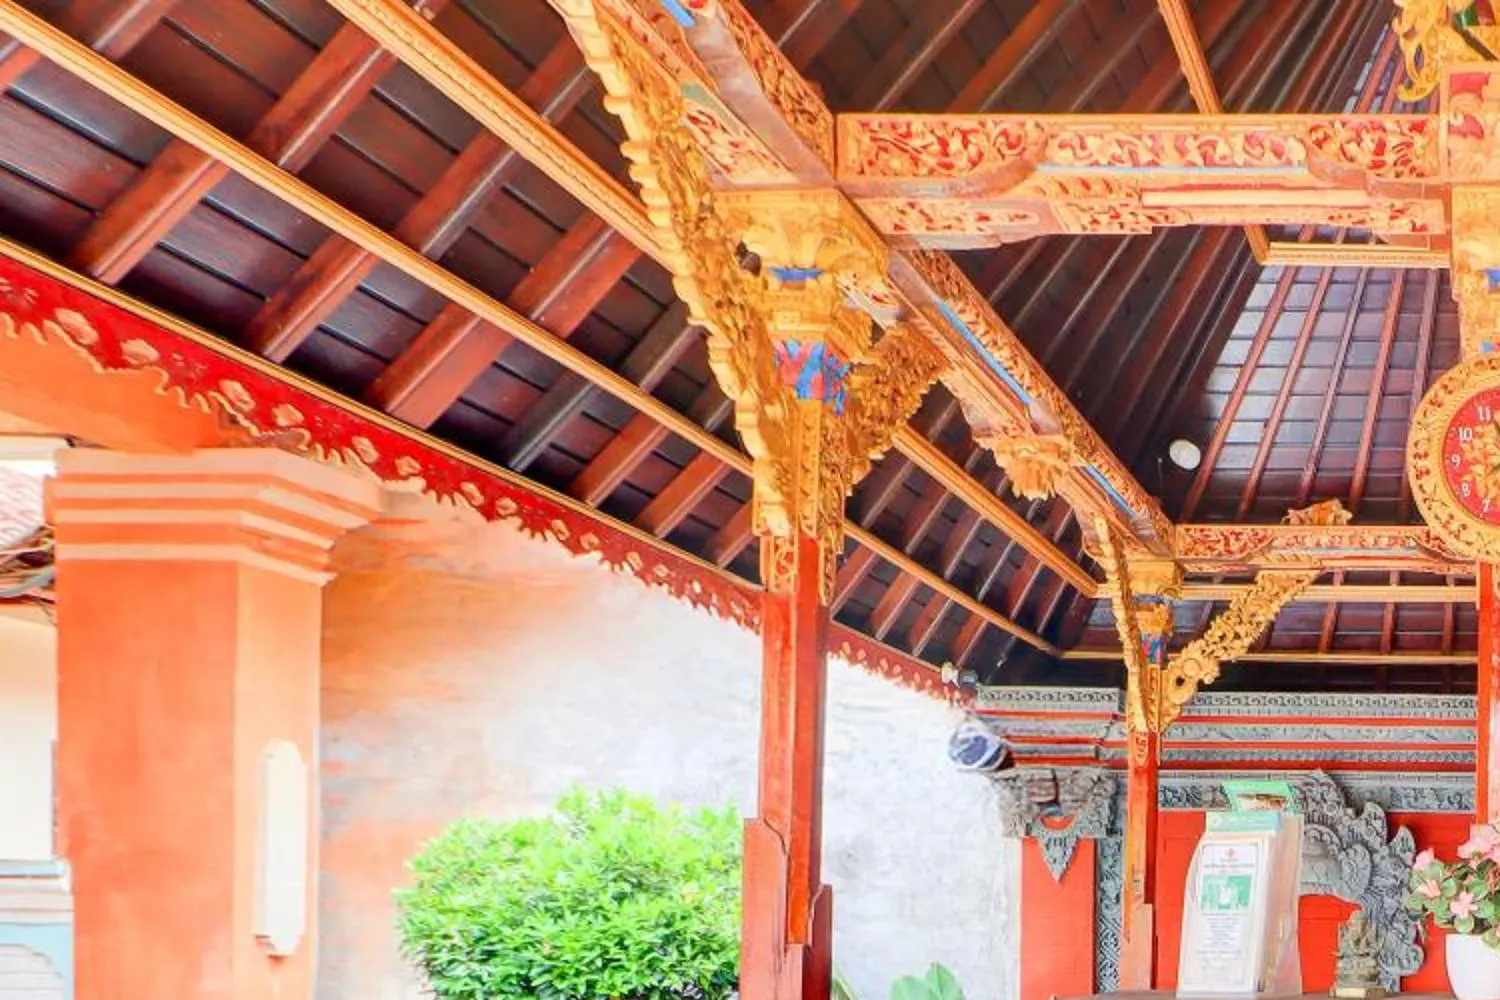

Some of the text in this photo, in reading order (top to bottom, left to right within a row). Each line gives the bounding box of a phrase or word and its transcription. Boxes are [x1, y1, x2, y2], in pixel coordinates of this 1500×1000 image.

[1478, 406, 1491, 420] 11
[1459, 427, 1473, 442] 10
[1451, 453, 1461, 469] 9
[1461, 482, 1471, 497] 8
[1482, 498, 1492, 514] 7
